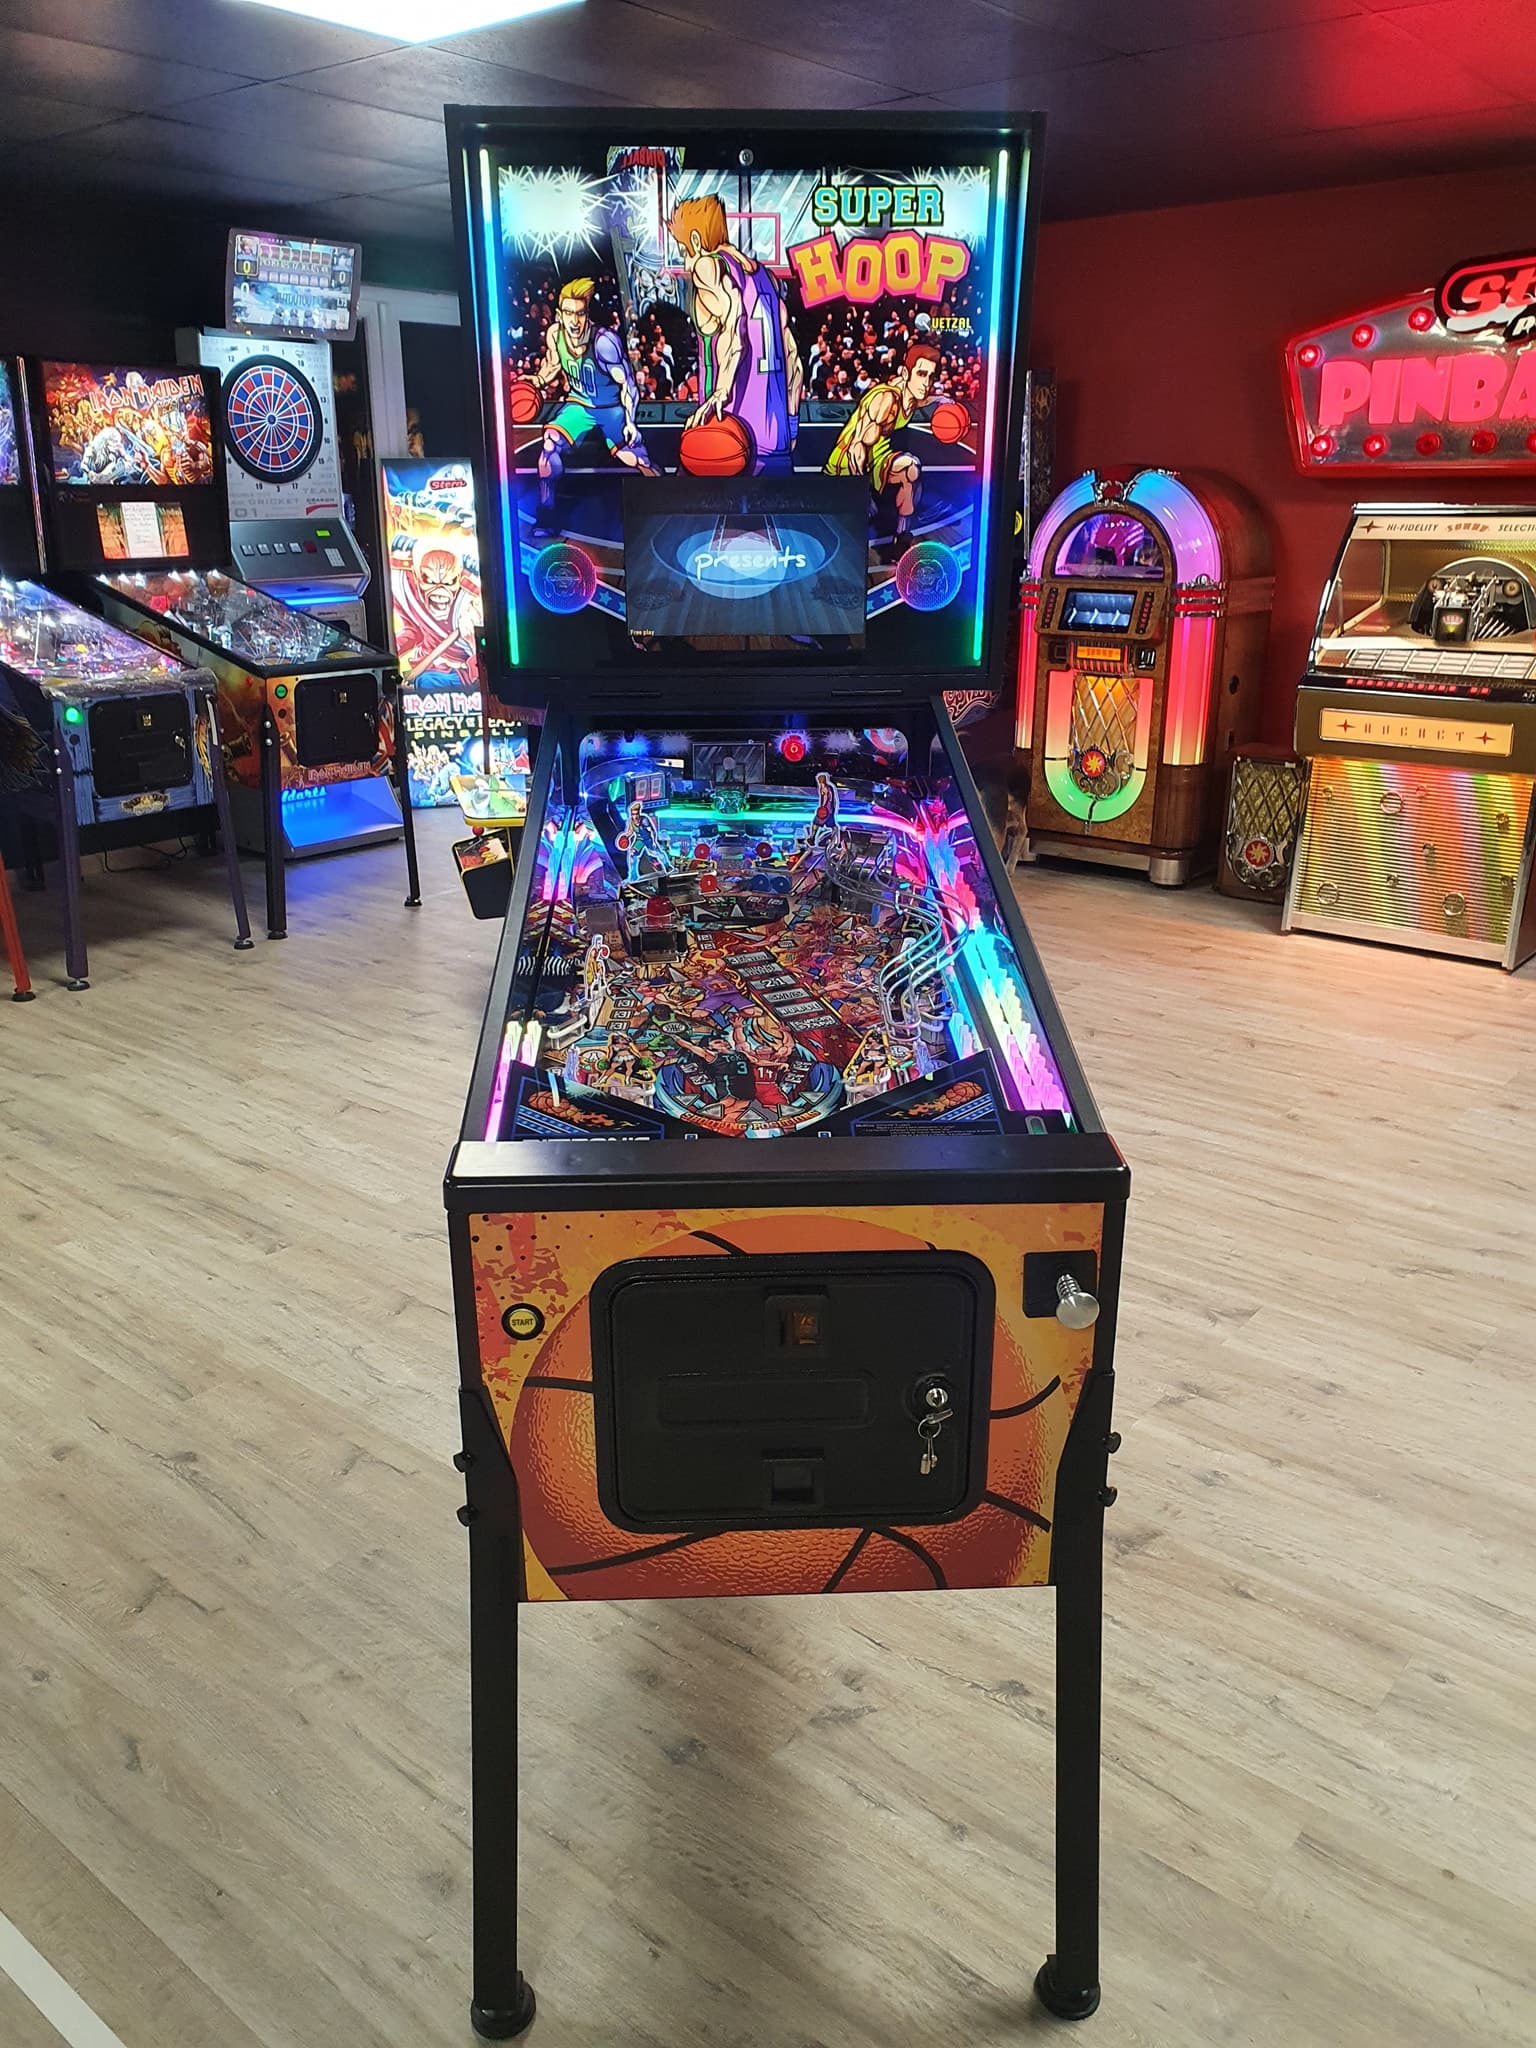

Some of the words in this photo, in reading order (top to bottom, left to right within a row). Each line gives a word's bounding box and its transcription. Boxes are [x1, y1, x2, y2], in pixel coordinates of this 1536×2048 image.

[813, 185, 944, 225] SUPER
[788, 230, 971, 308] HOOP
[89, 386, 137, 415] IRON
[136, 374, 205, 408] MAIDEN
[431, 480, 466, 490] Stern
[1386, 523, 1439, 532] HI-FIDELITY
[1498, 523, 1536, 532] SELECTI
[695, 546, 807, 580] presents
[643, 629, 655, 637] play
[403, 693, 450, 716] IRON
[406, 717, 464, 732] LEGACY
[414, 728, 514, 739] PINBALL
[761, 978, 787, 988] 21
[757, 1066, 773, 1079] 14
[511, 1318, 534, 1327] START
